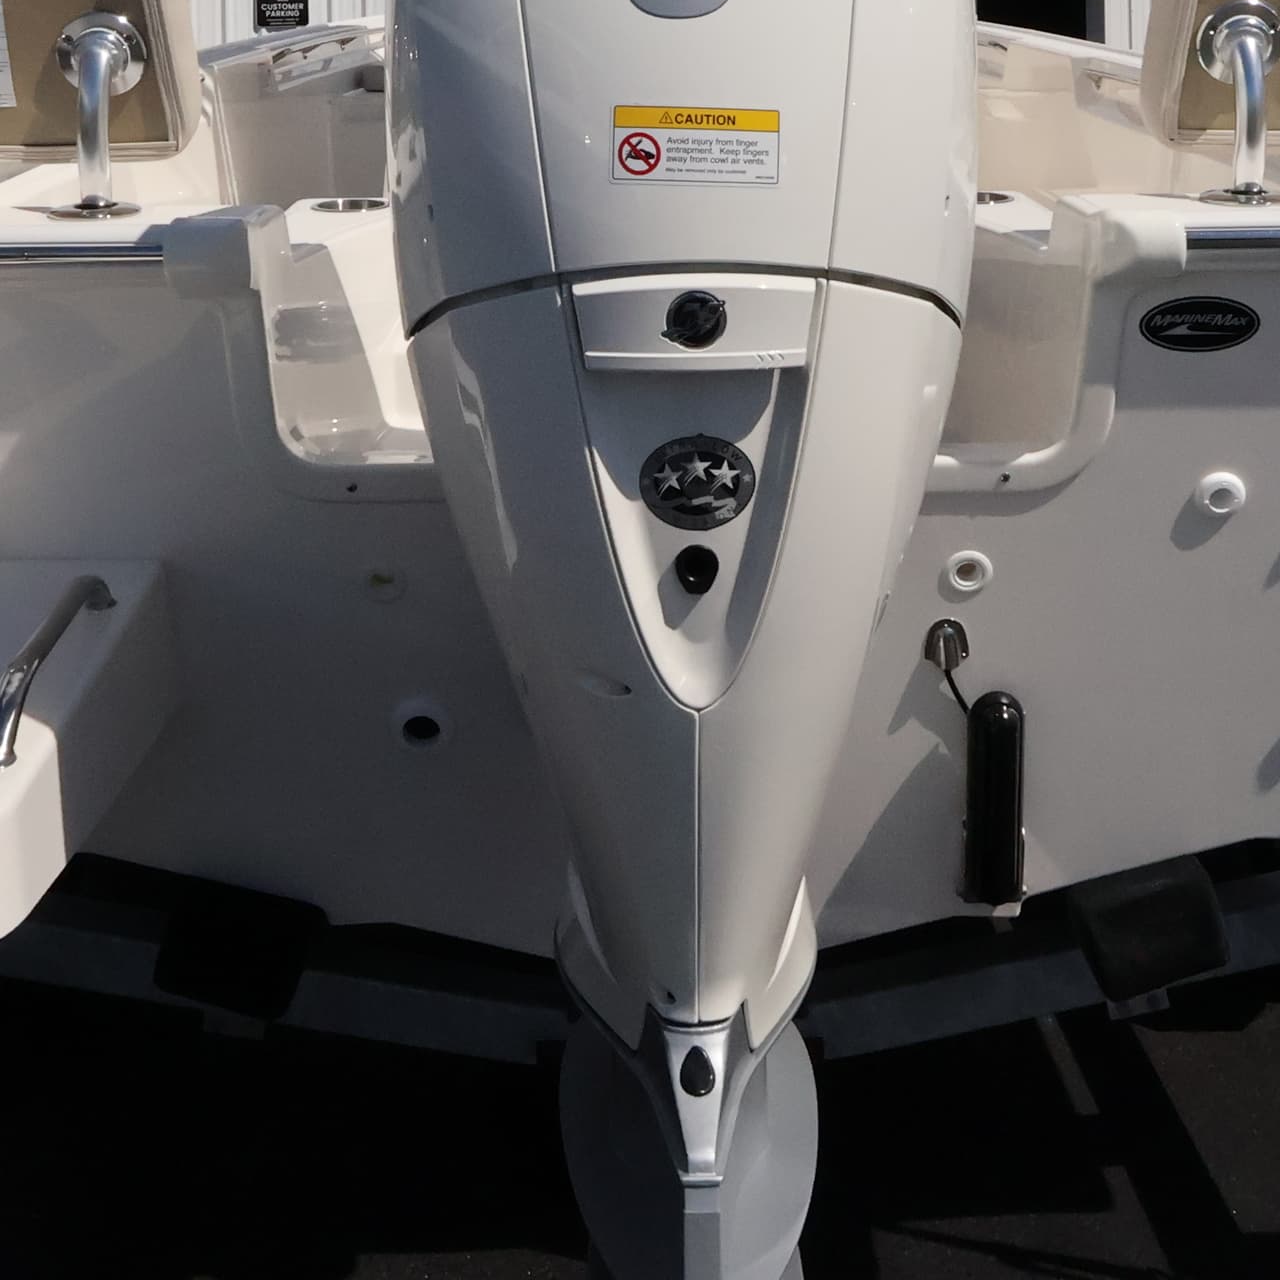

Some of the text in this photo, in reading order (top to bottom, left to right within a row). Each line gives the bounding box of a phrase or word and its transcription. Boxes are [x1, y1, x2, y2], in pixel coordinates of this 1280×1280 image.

[261, 2, 304, 11] CUSTOMER
[674, 113, 736, 126] CAUTION
[666, 137, 759, 149] Avoid injury from finger
[719, 148, 741, 156] Keep
[742, 149, 769, 157] fingers
[666, 156, 687, 164] away
[689, 155, 708, 163] from
[710, 156, 729, 164] cowl
